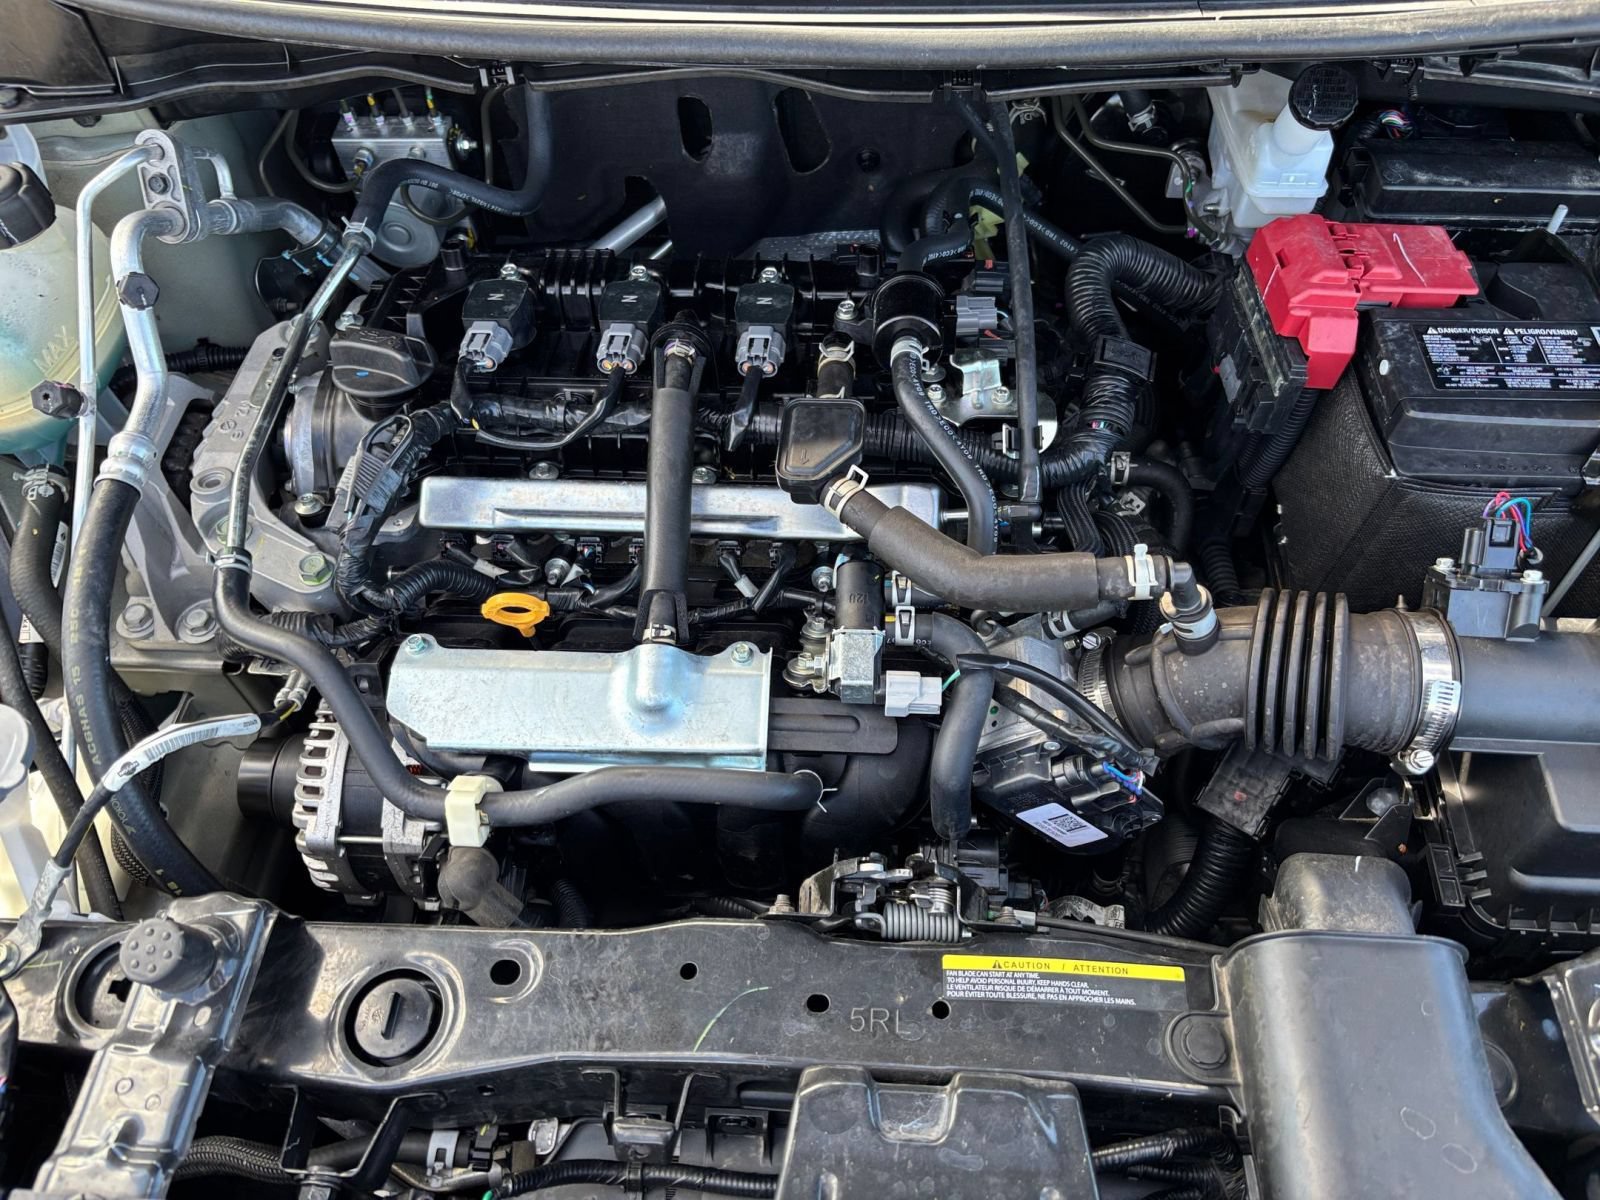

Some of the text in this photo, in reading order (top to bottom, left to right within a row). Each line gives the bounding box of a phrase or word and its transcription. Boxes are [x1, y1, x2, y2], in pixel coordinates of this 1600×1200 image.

[1003, 961, 1051, 970] CAUTION
[1073, 964, 1129, 975] ATTENTION
[954, 983, 994, 991] VENTILATEUR
[1065, 987, 1081, 995] TOUT
[1081, 988, 1110, 997] MOMENT.
[1071, 981, 1090, 989] CLEAR.
[1037, 992, 1046, 1000] NE
[1068, 994, 1103, 1003] APPROCHER
[1104, 996, 1115, 1004] LES
[1115, 997, 1137, 1005] MAINS.
